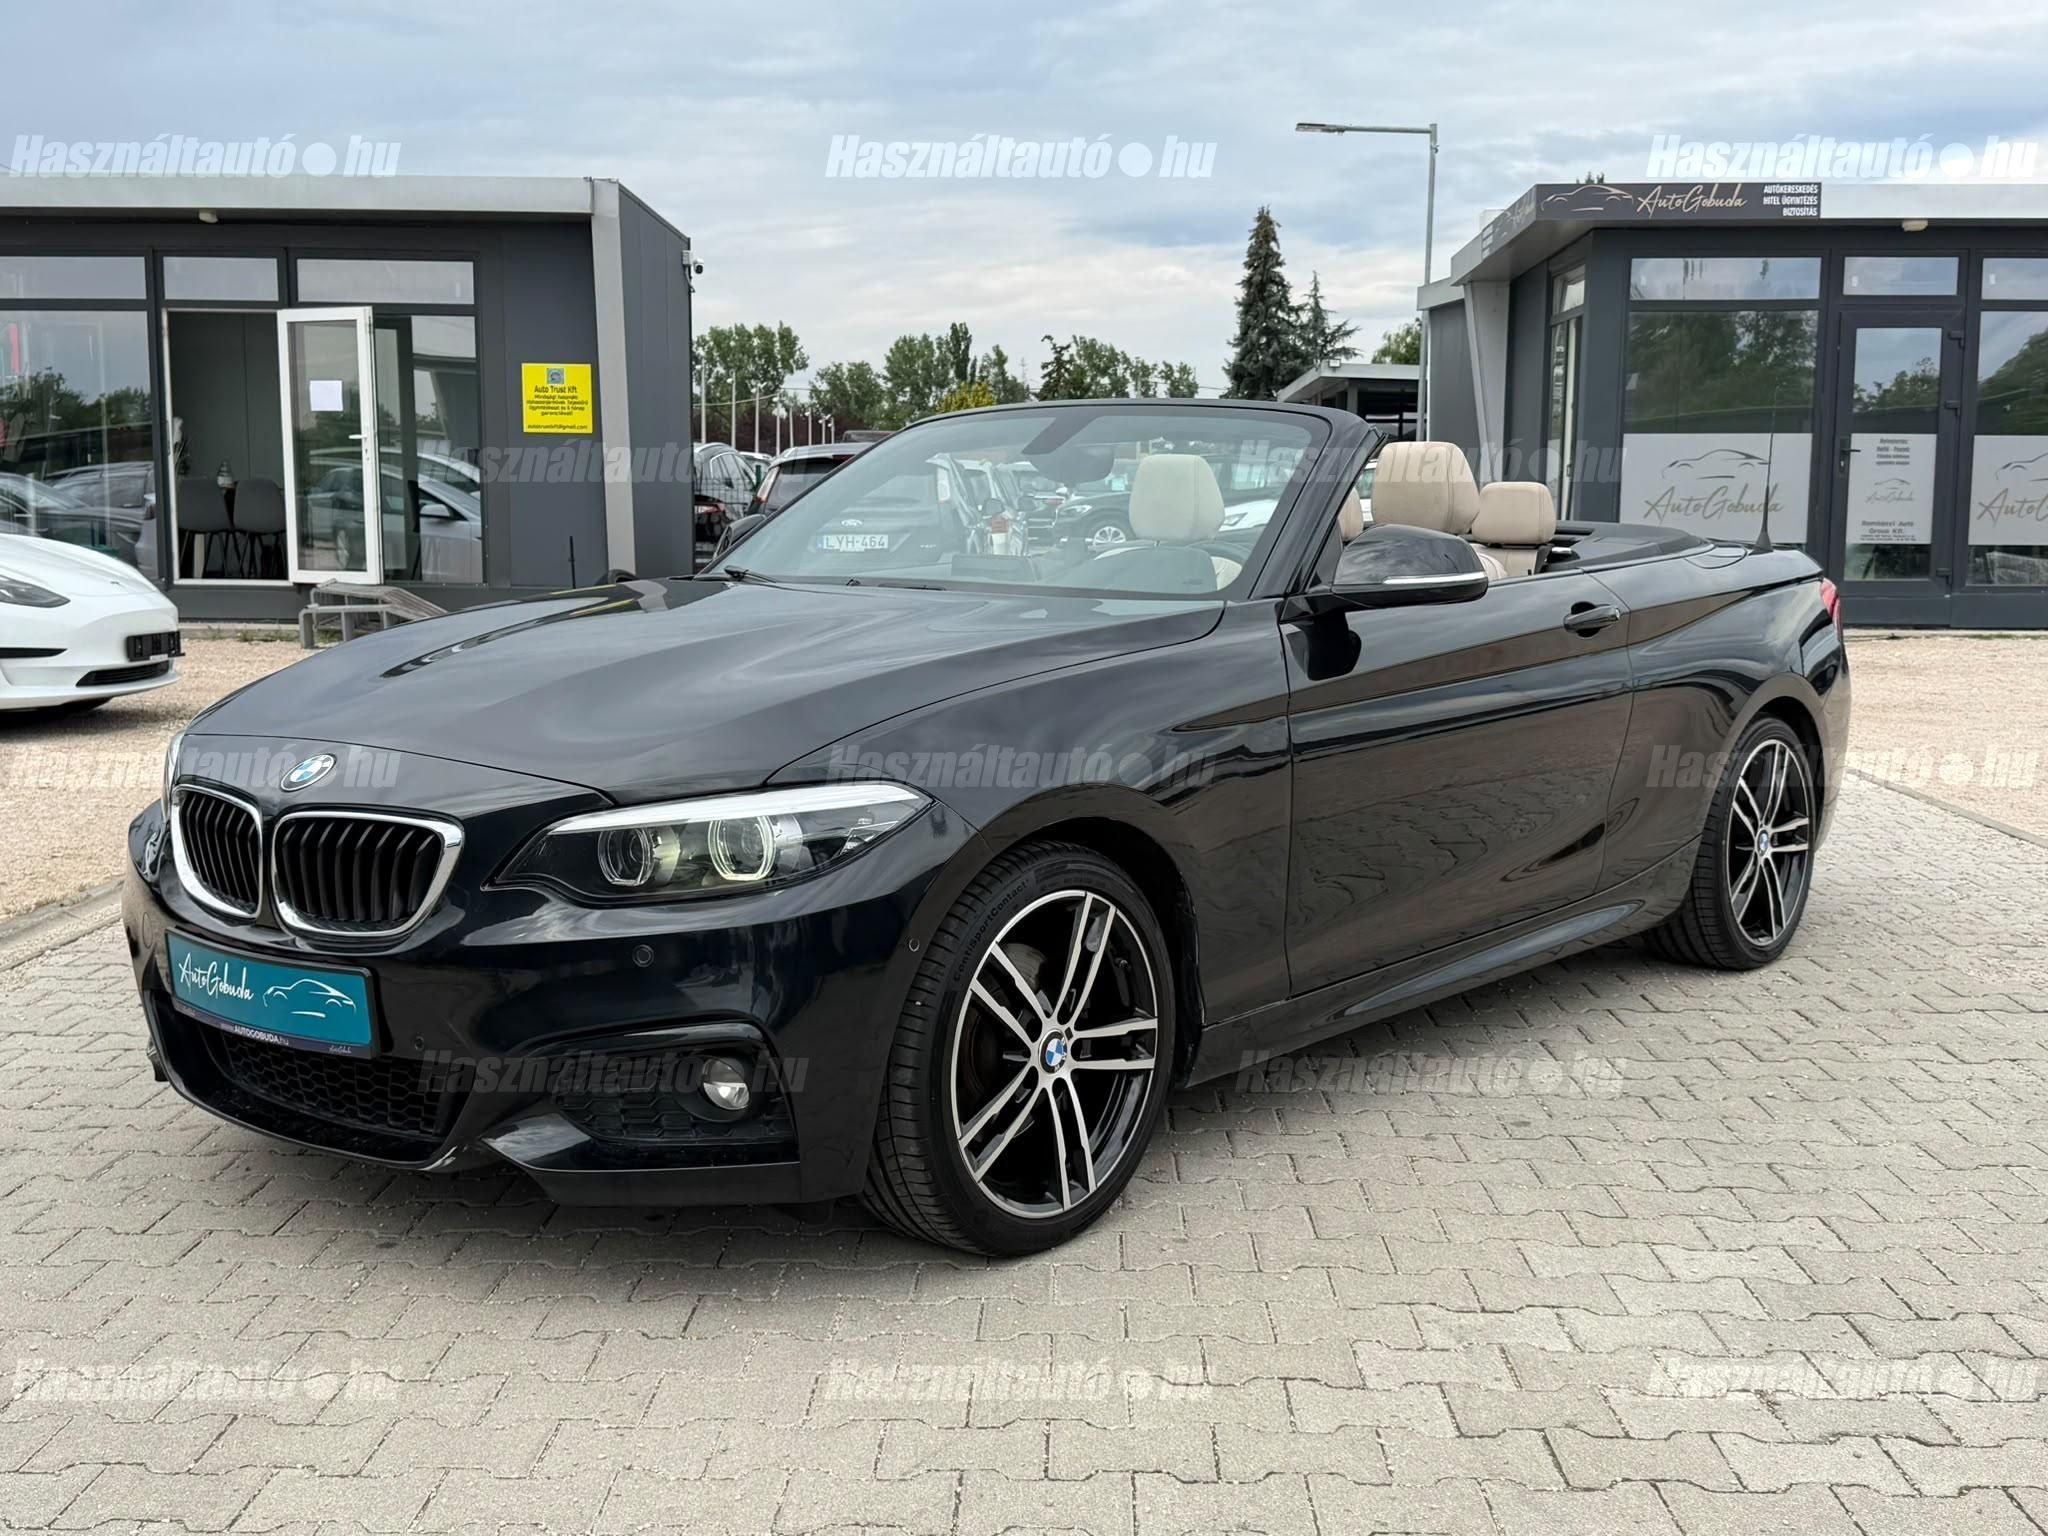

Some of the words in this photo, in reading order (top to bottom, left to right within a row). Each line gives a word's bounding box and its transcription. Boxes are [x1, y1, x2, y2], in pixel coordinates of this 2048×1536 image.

[1637, 183, 1748, 218] AutoGobuda
[1763, 195, 1781, 205] HITEL
[534, 385, 549, 393] Auto
[825, 535, 886, 548] LYH-464
[178, 952, 254, 999] AutoGobuda
